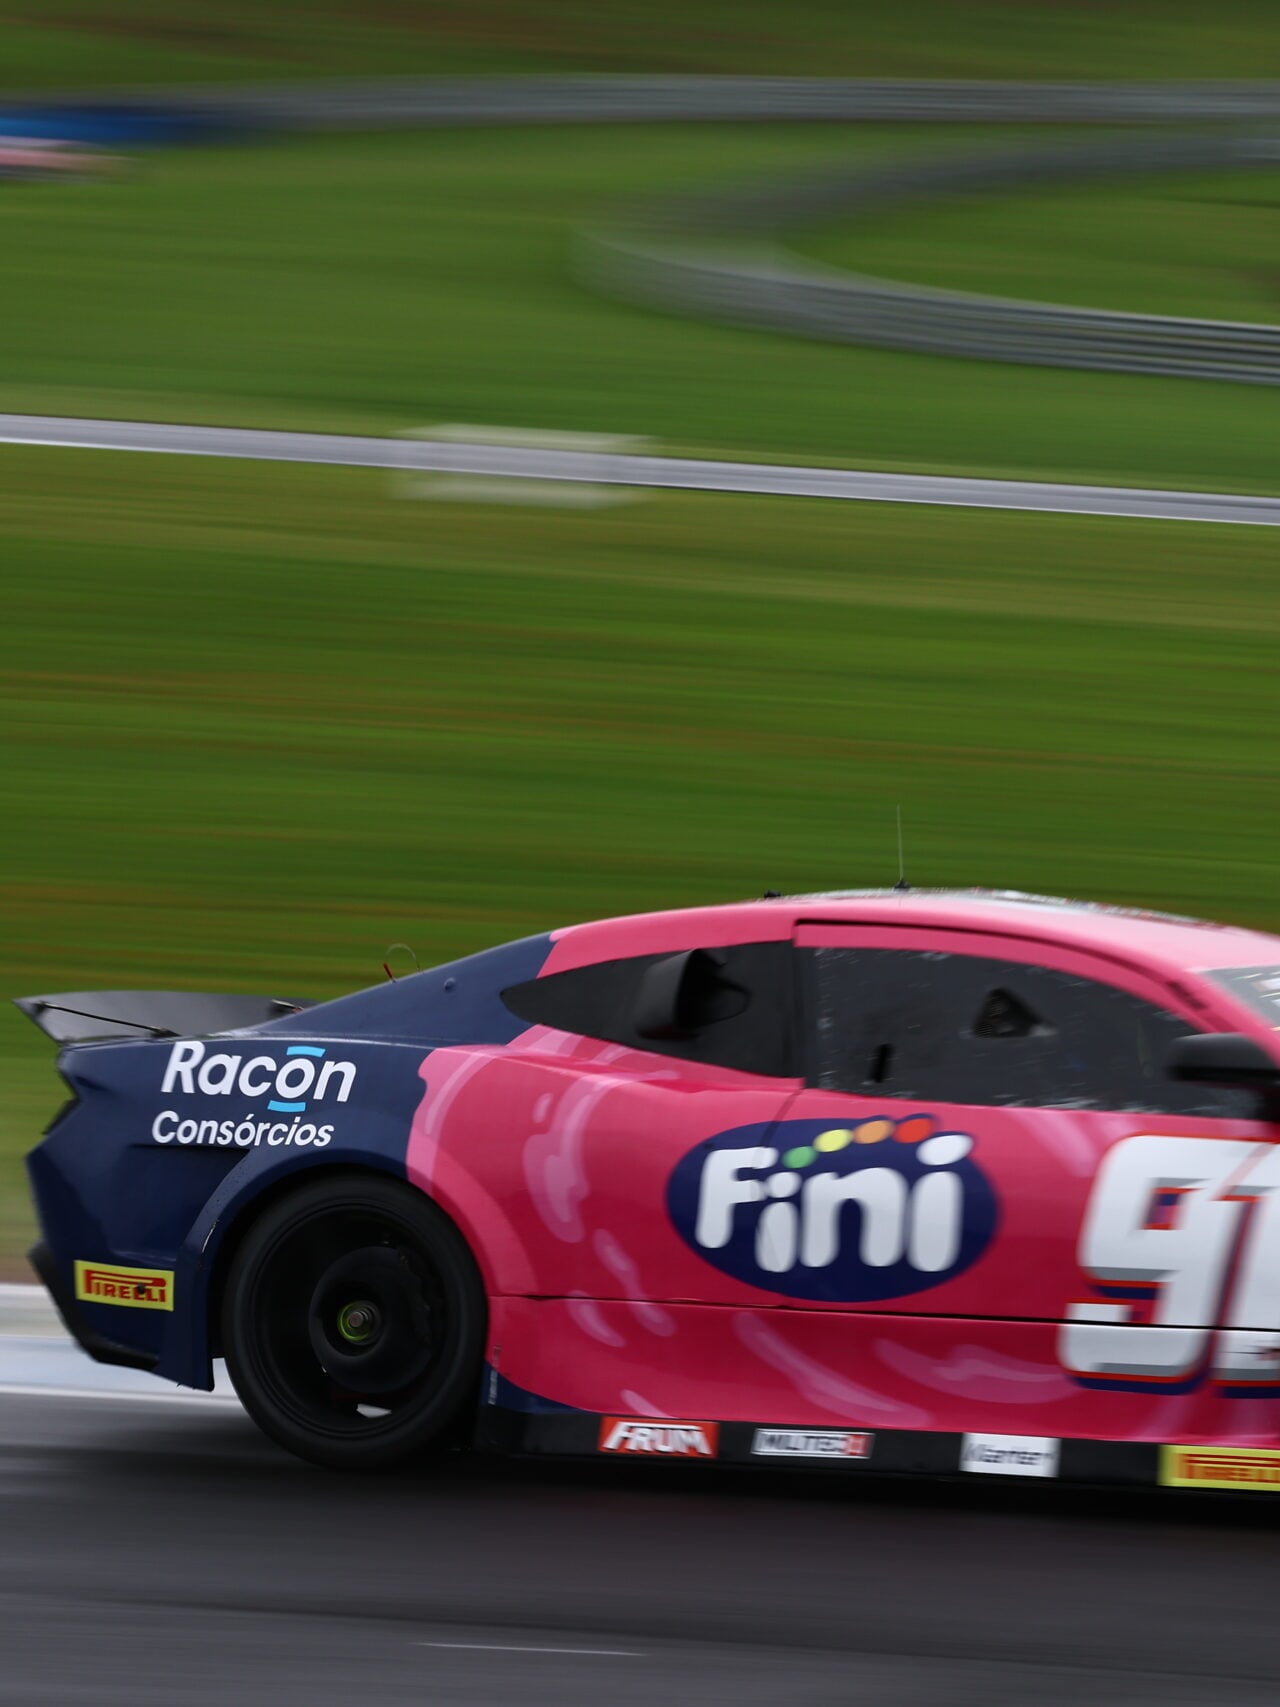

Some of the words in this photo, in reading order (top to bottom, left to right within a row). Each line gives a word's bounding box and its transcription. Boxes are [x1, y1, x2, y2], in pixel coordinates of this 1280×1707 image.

[152, 1110, 335, 1147] Consórcios
[695, 1135, 974, 1273] Fini
[83, 1269, 167, 1303] PIRELLI
